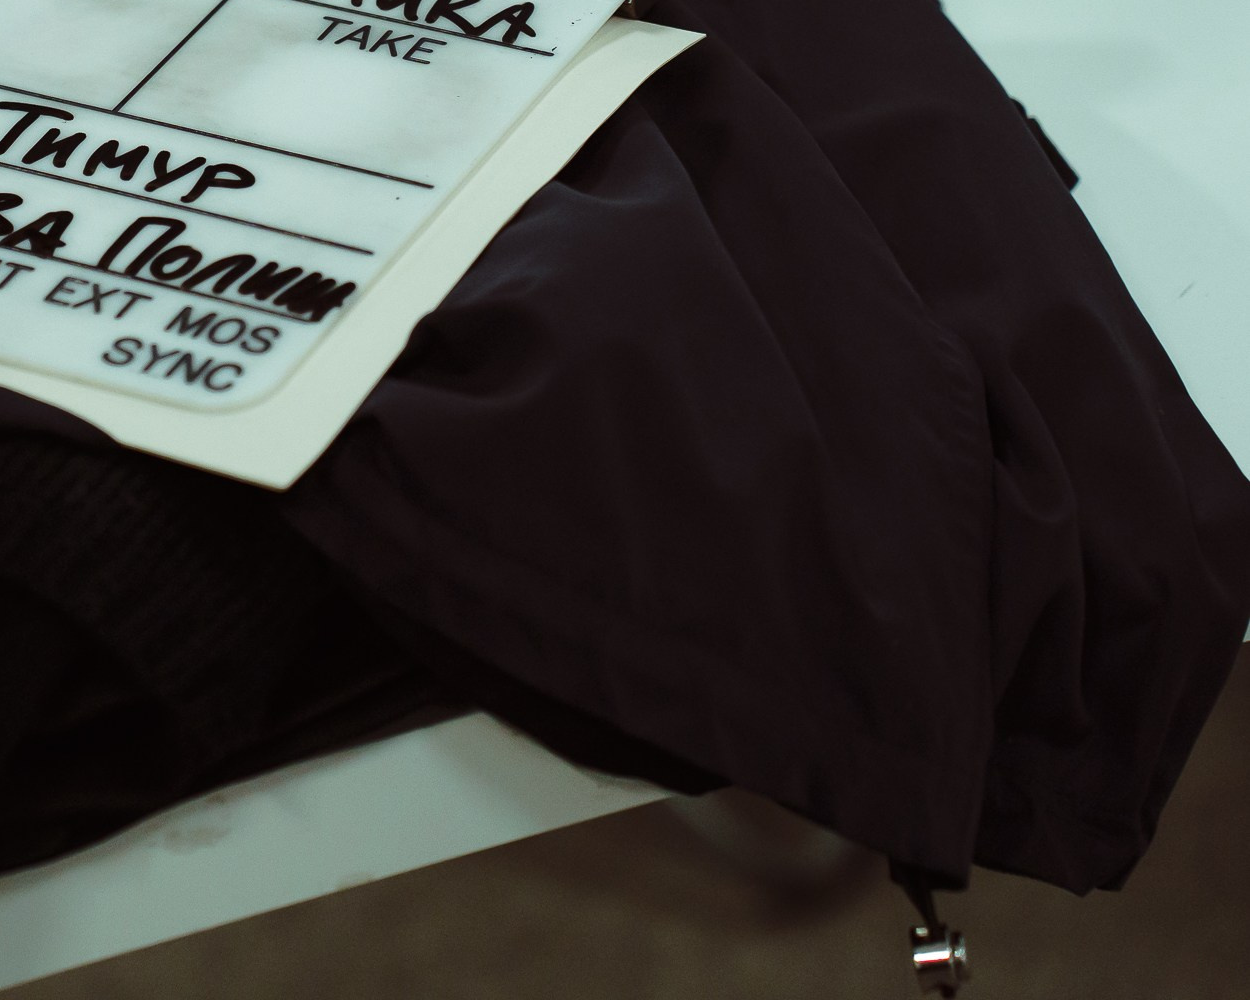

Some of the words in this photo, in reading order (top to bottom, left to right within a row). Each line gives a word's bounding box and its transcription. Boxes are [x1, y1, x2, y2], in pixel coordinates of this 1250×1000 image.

[316, 16, 448, 64] TAKE
[44, 276, 152, 319] EXT
[165, 306, 281, 354] MOS
[102, 336, 243, 392] SYNC
